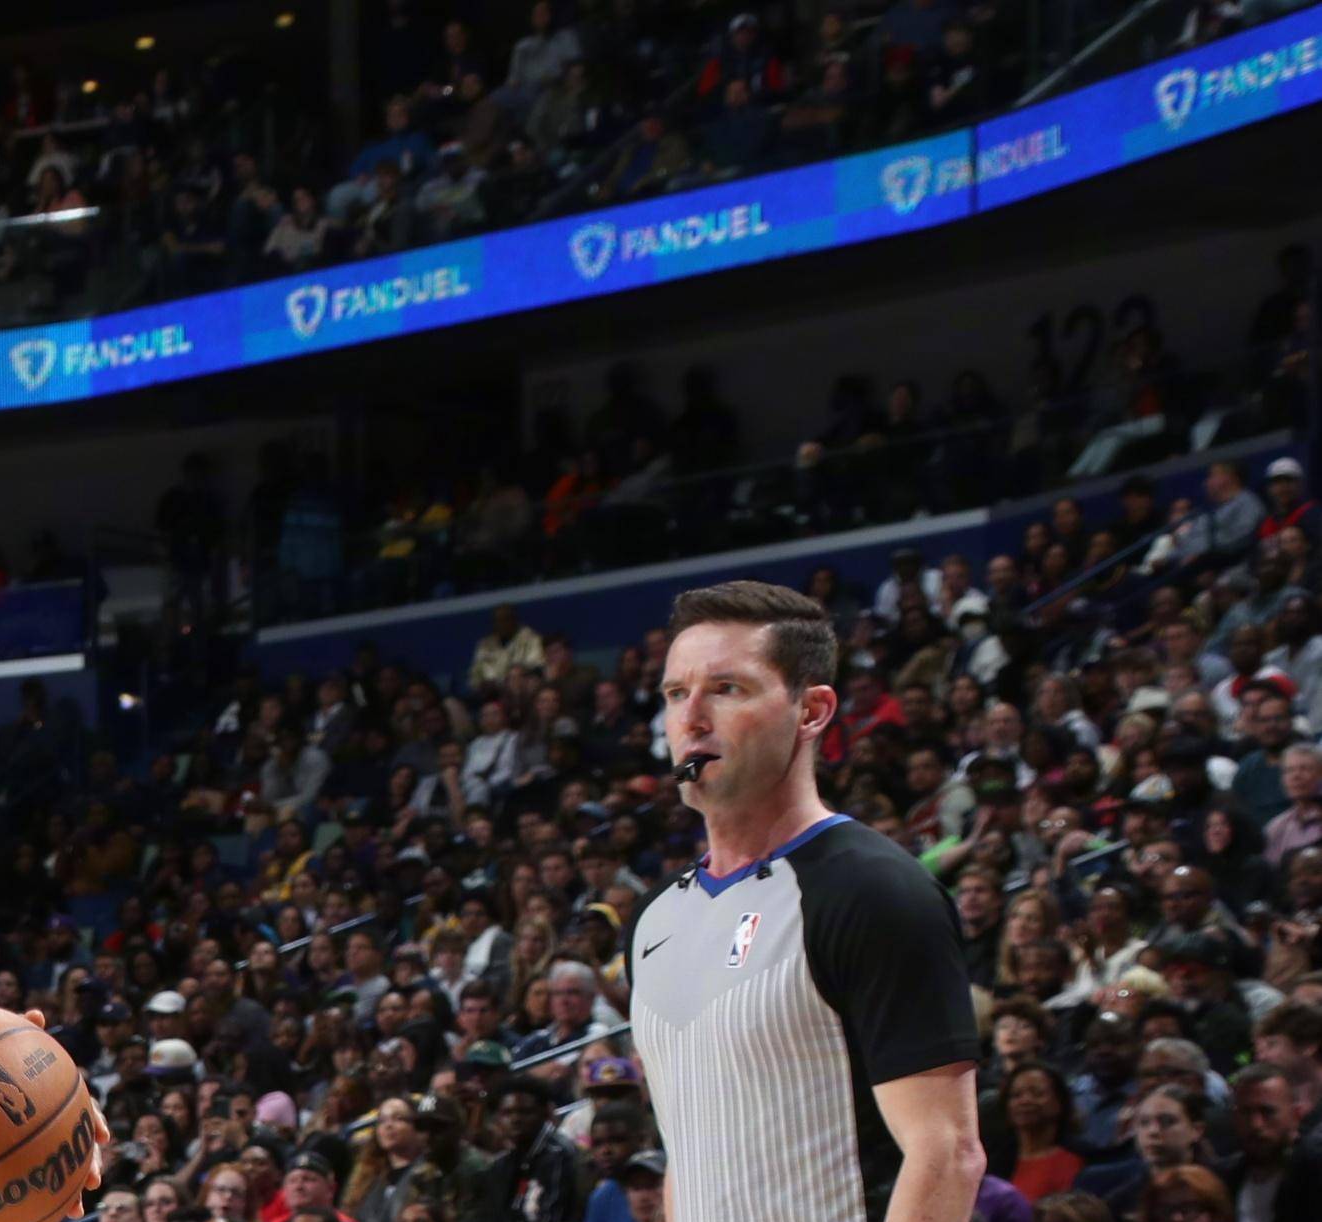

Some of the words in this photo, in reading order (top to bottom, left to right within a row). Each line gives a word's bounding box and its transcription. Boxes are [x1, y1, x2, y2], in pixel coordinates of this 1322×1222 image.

[620, 203, 770, 261] FANDUEL
[331, 266, 470, 321] FANDUEL
[63, 325, 193, 375] FANDUEL
